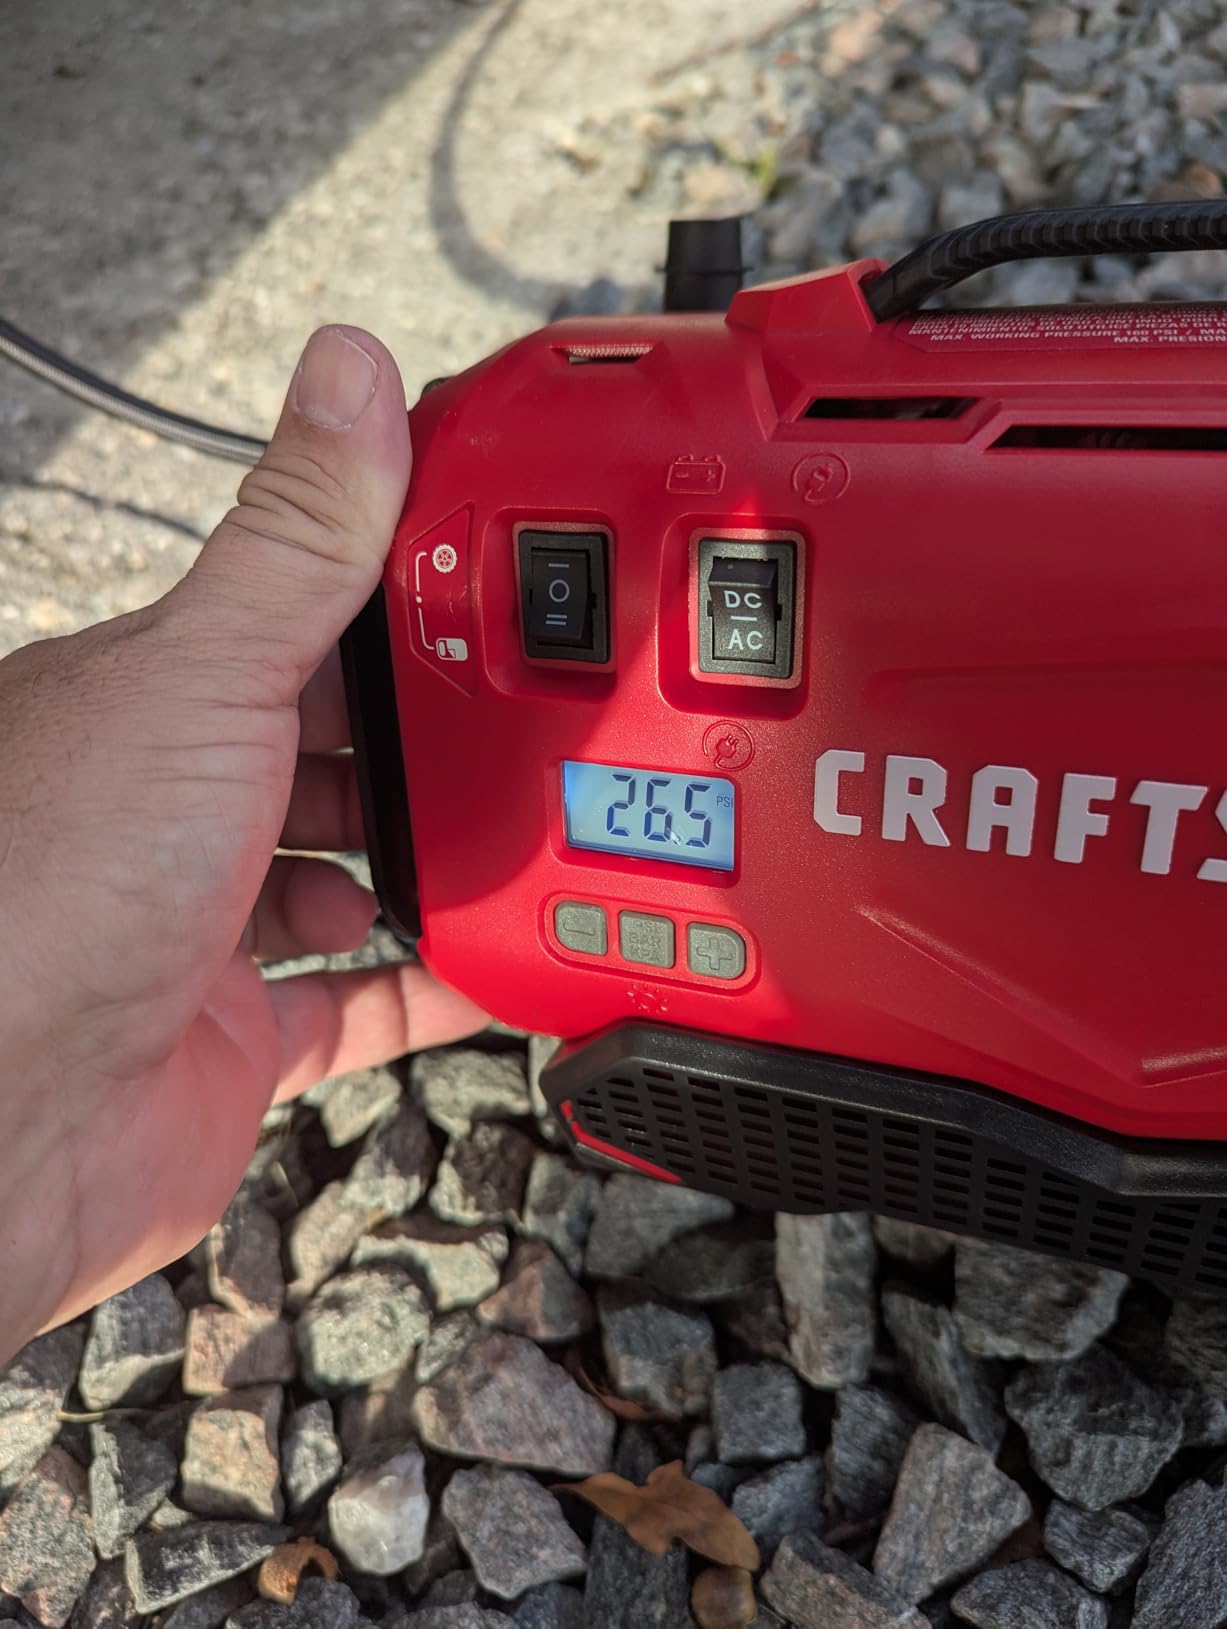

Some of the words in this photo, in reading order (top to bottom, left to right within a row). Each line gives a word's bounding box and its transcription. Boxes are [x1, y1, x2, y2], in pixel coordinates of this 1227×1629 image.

[970, 331, 1040, 340] WORKING
[1044, 330, 1121, 338] PRESSURE
[724, 590, 763, 609] DC
[728, 630, 763, 651] AC
[716, 795, 733, 808] PSI
[629, 932, 661, 947] BAR
